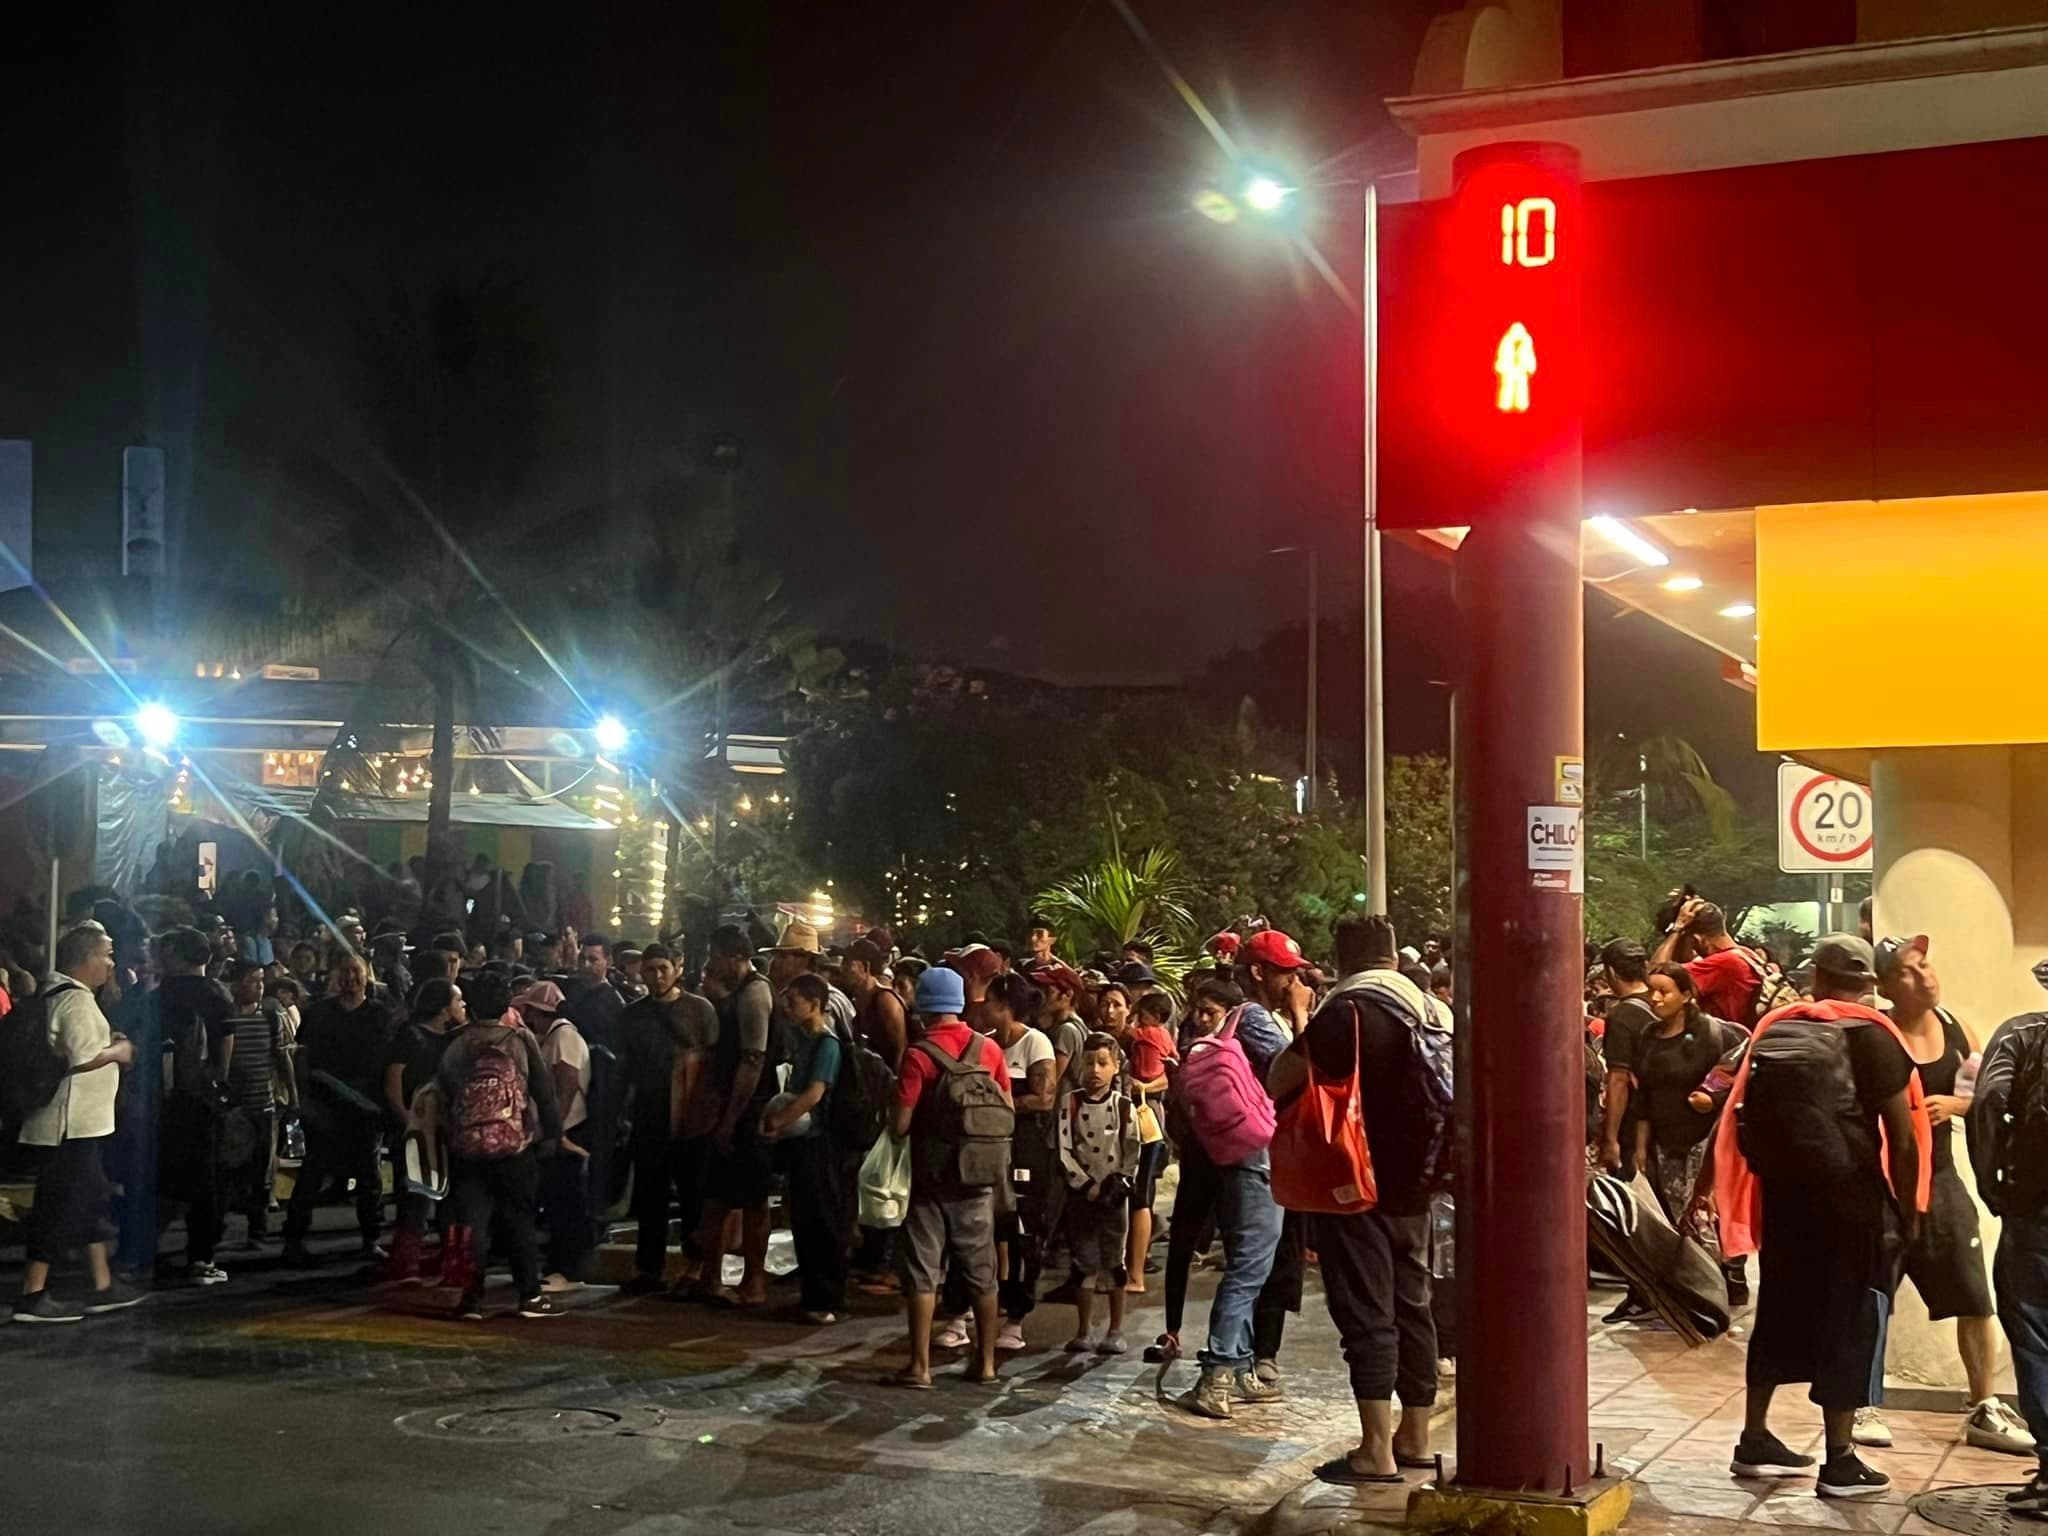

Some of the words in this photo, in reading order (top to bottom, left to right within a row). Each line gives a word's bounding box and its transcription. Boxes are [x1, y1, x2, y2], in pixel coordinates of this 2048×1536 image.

[1501, 198, 1556, 268] 10
[1814, 791, 1863, 829] 20
[1817, 833, 1857, 842] km/h
